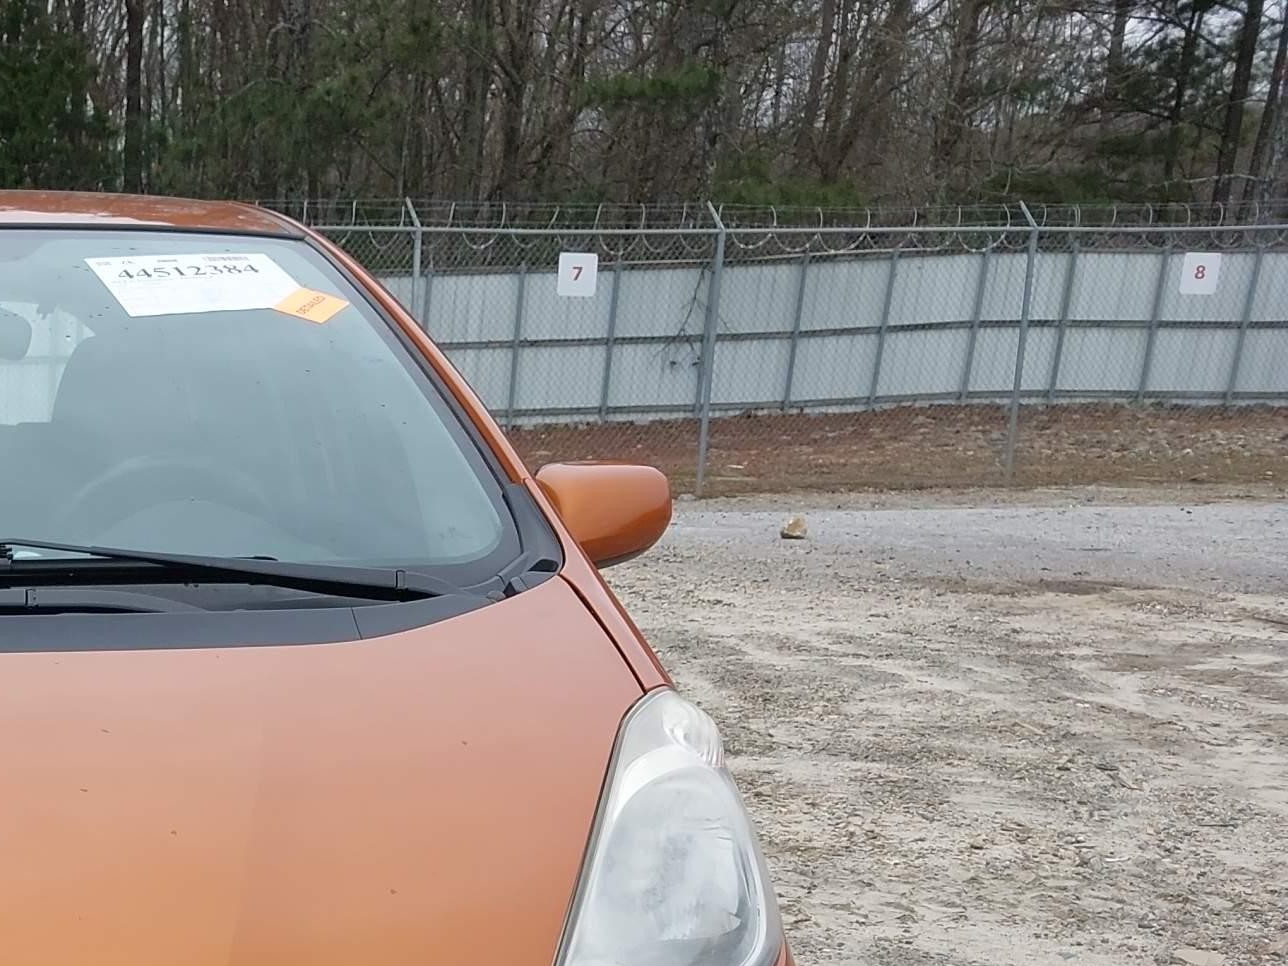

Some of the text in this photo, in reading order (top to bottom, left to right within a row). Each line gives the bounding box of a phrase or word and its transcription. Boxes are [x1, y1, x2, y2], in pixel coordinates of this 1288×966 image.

[117, 263, 260, 280] 44512384
[572, 266, 584, 281] 7
[1194, 264, 1206, 280] 8
